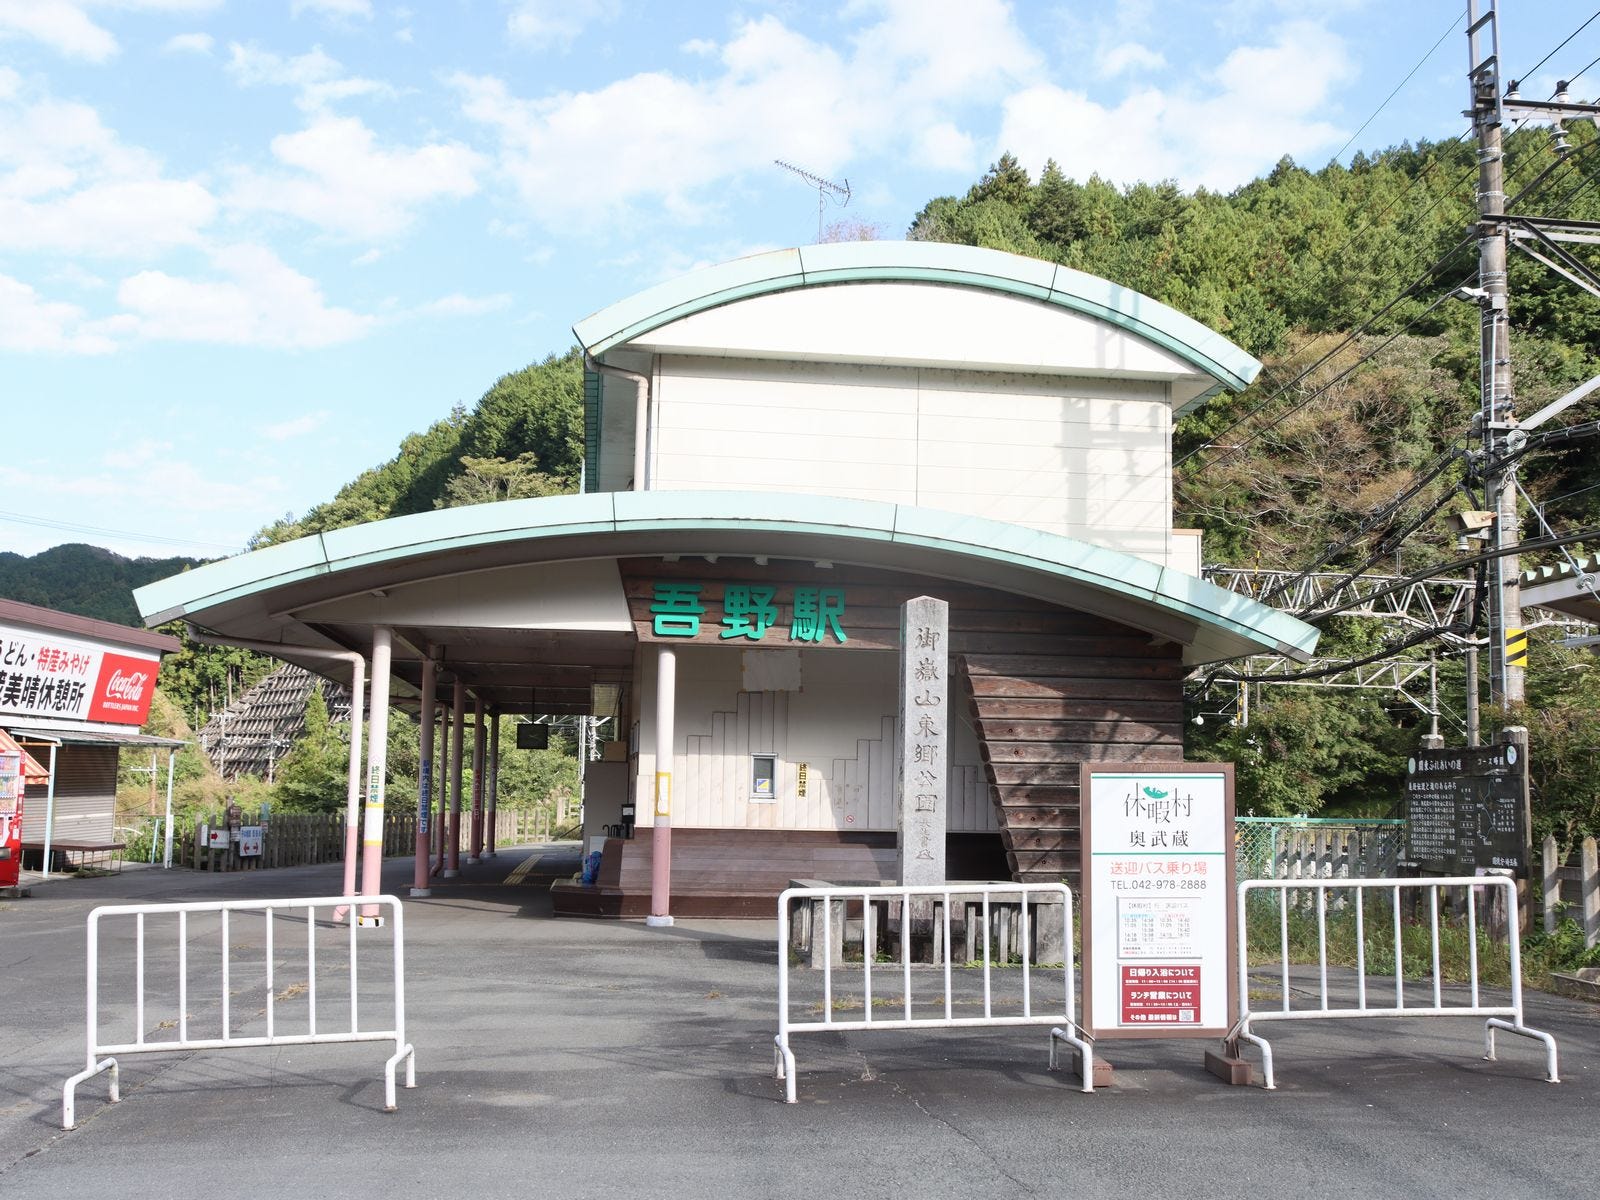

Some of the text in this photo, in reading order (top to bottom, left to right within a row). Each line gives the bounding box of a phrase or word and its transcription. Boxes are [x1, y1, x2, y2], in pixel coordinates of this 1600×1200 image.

[650, 583, 847, 642] 吾野駅
[370, 765, 380, 803] 終日禁煙
[798, 762, 807, 798] 終日禁煙
[1123, 782, 1194, 824] 休暇村
[1130, 830, 1189, 847] 奥武蔵
[1110, 861, 1207, 875] 送迎バス乗り場
[1111, 880, 1207, 890] TEL.042-978-2888
